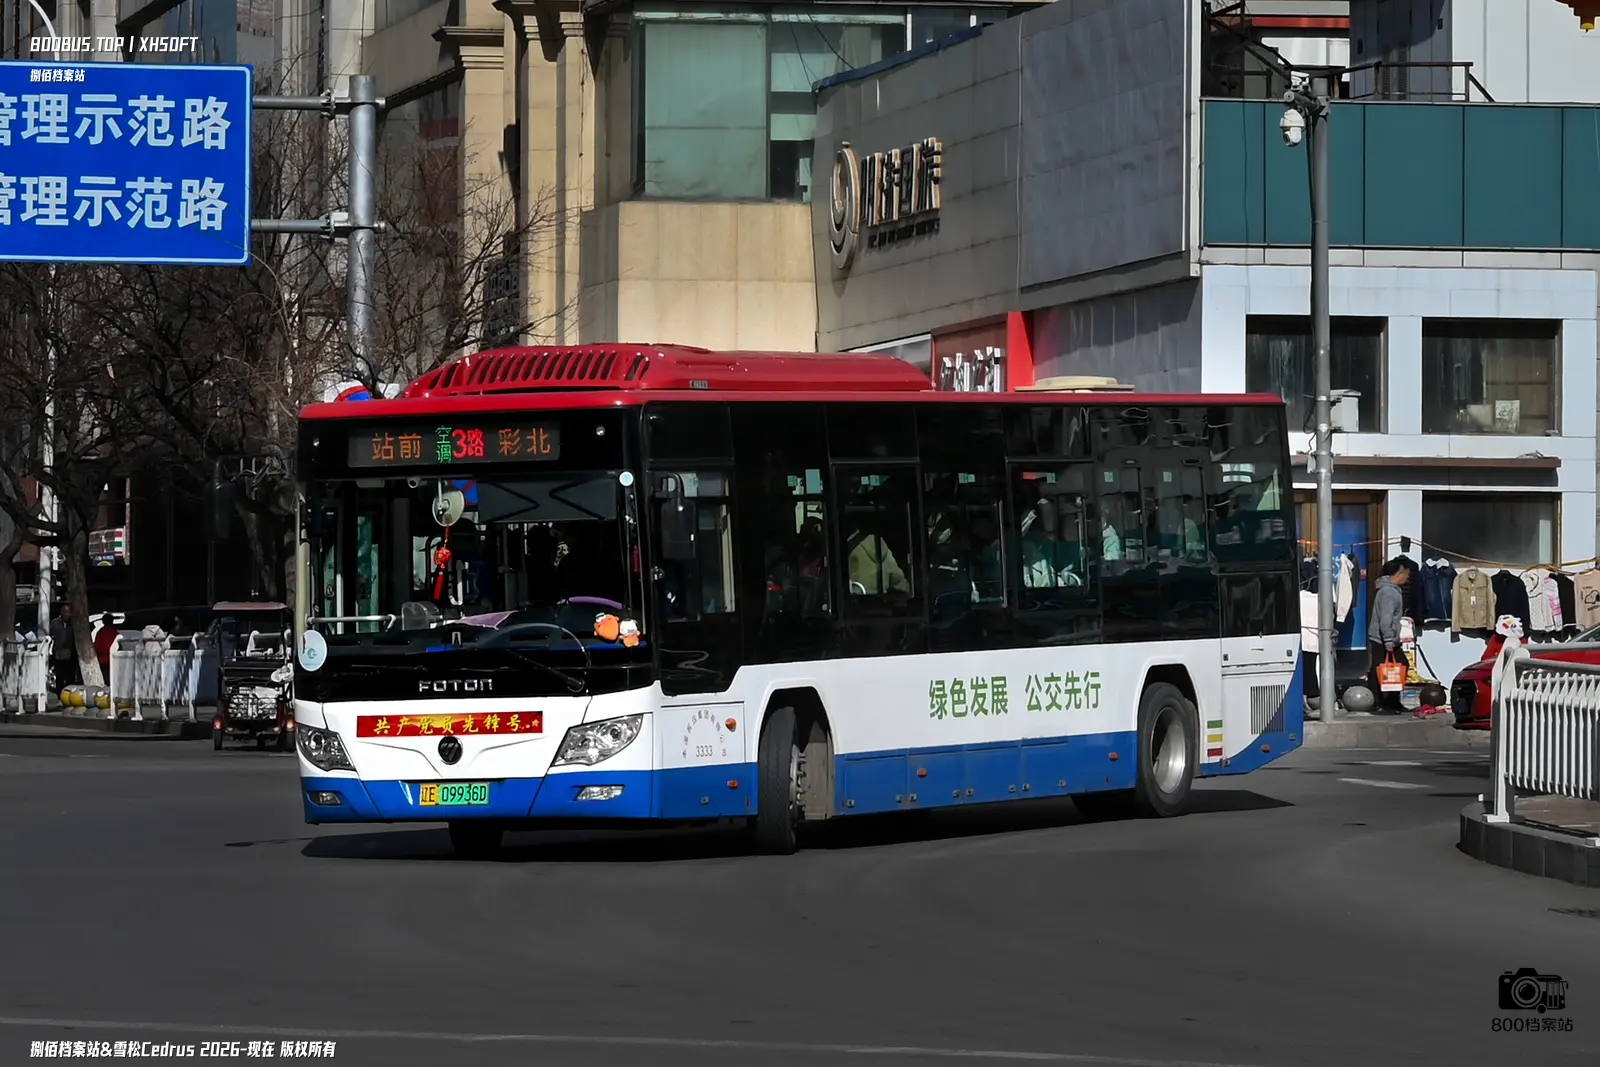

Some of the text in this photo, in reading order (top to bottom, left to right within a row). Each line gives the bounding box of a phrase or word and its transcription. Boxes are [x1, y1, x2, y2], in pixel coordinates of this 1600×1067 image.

[371, 424, 551, 464] 站前 空调 3路 彩北
[418, 678, 494, 693] FOTON
[928, 669, 1102, 720] 绿色发展 公交先行
[372, 713, 521, 736] 共产党员先锋号
[695, 744, 714, 758] 3333
